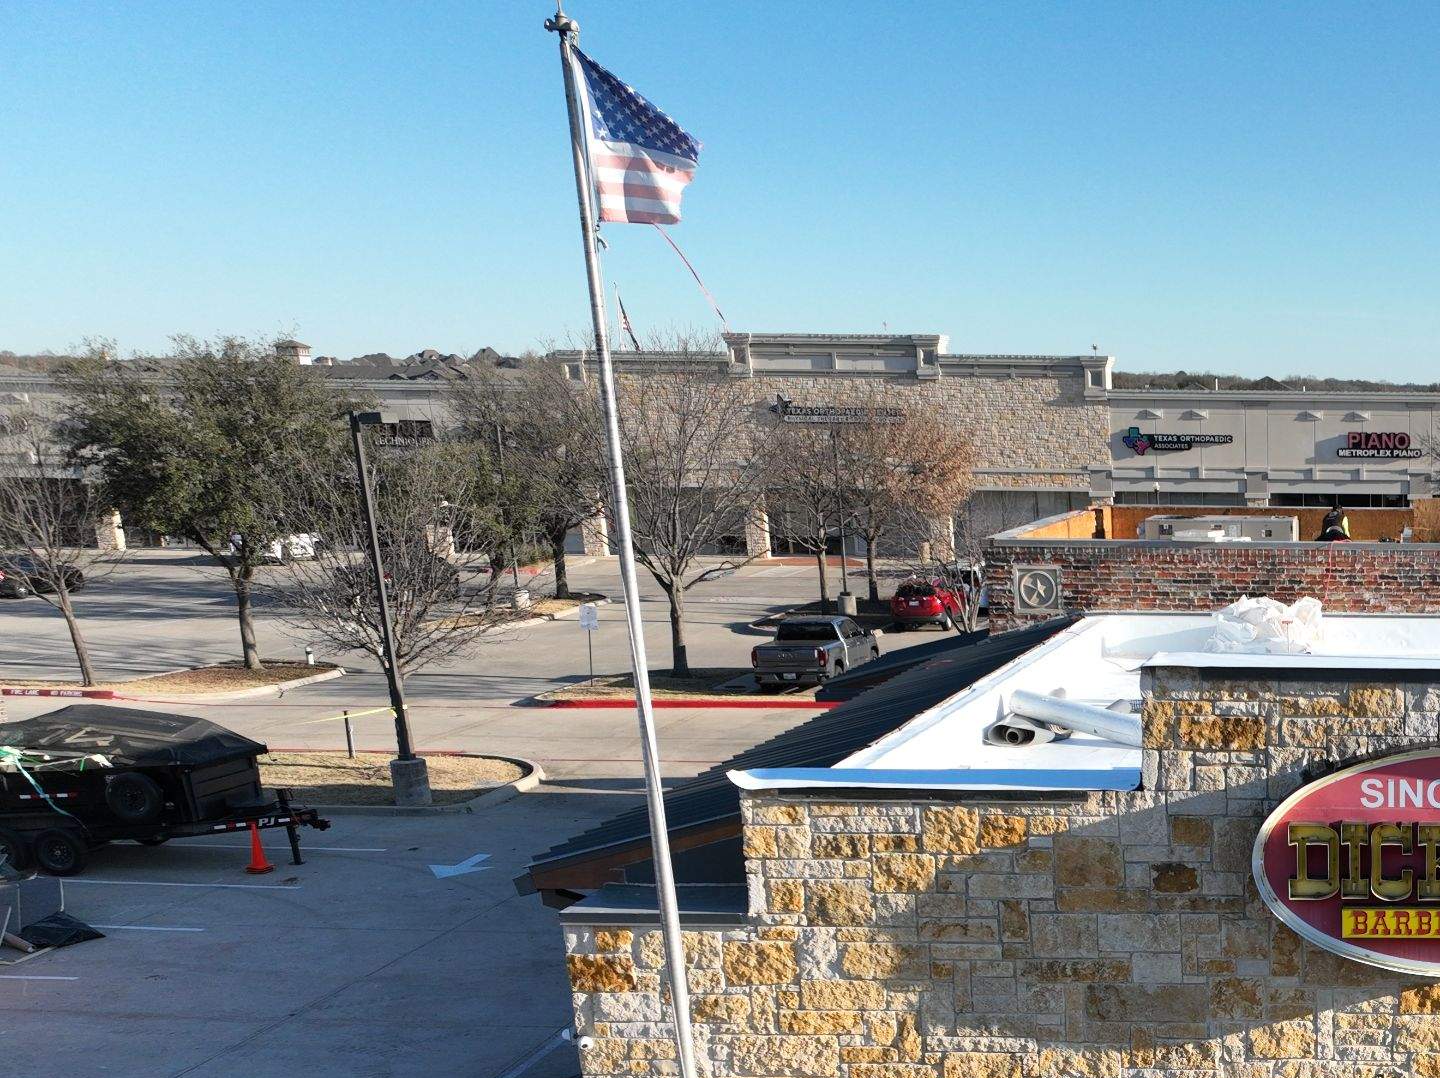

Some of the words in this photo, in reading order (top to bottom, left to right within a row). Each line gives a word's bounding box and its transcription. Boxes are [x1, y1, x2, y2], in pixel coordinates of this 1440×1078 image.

[1179, 435, 1233, 443] ORTHOPAEDIC
[1347, 431, 1411, 449] PIANO
[1338, 449, 1392, 457] METROPLEX
[1393, 449, 1421, 457] PIANO
[258, 818, 275, 827] PJ
